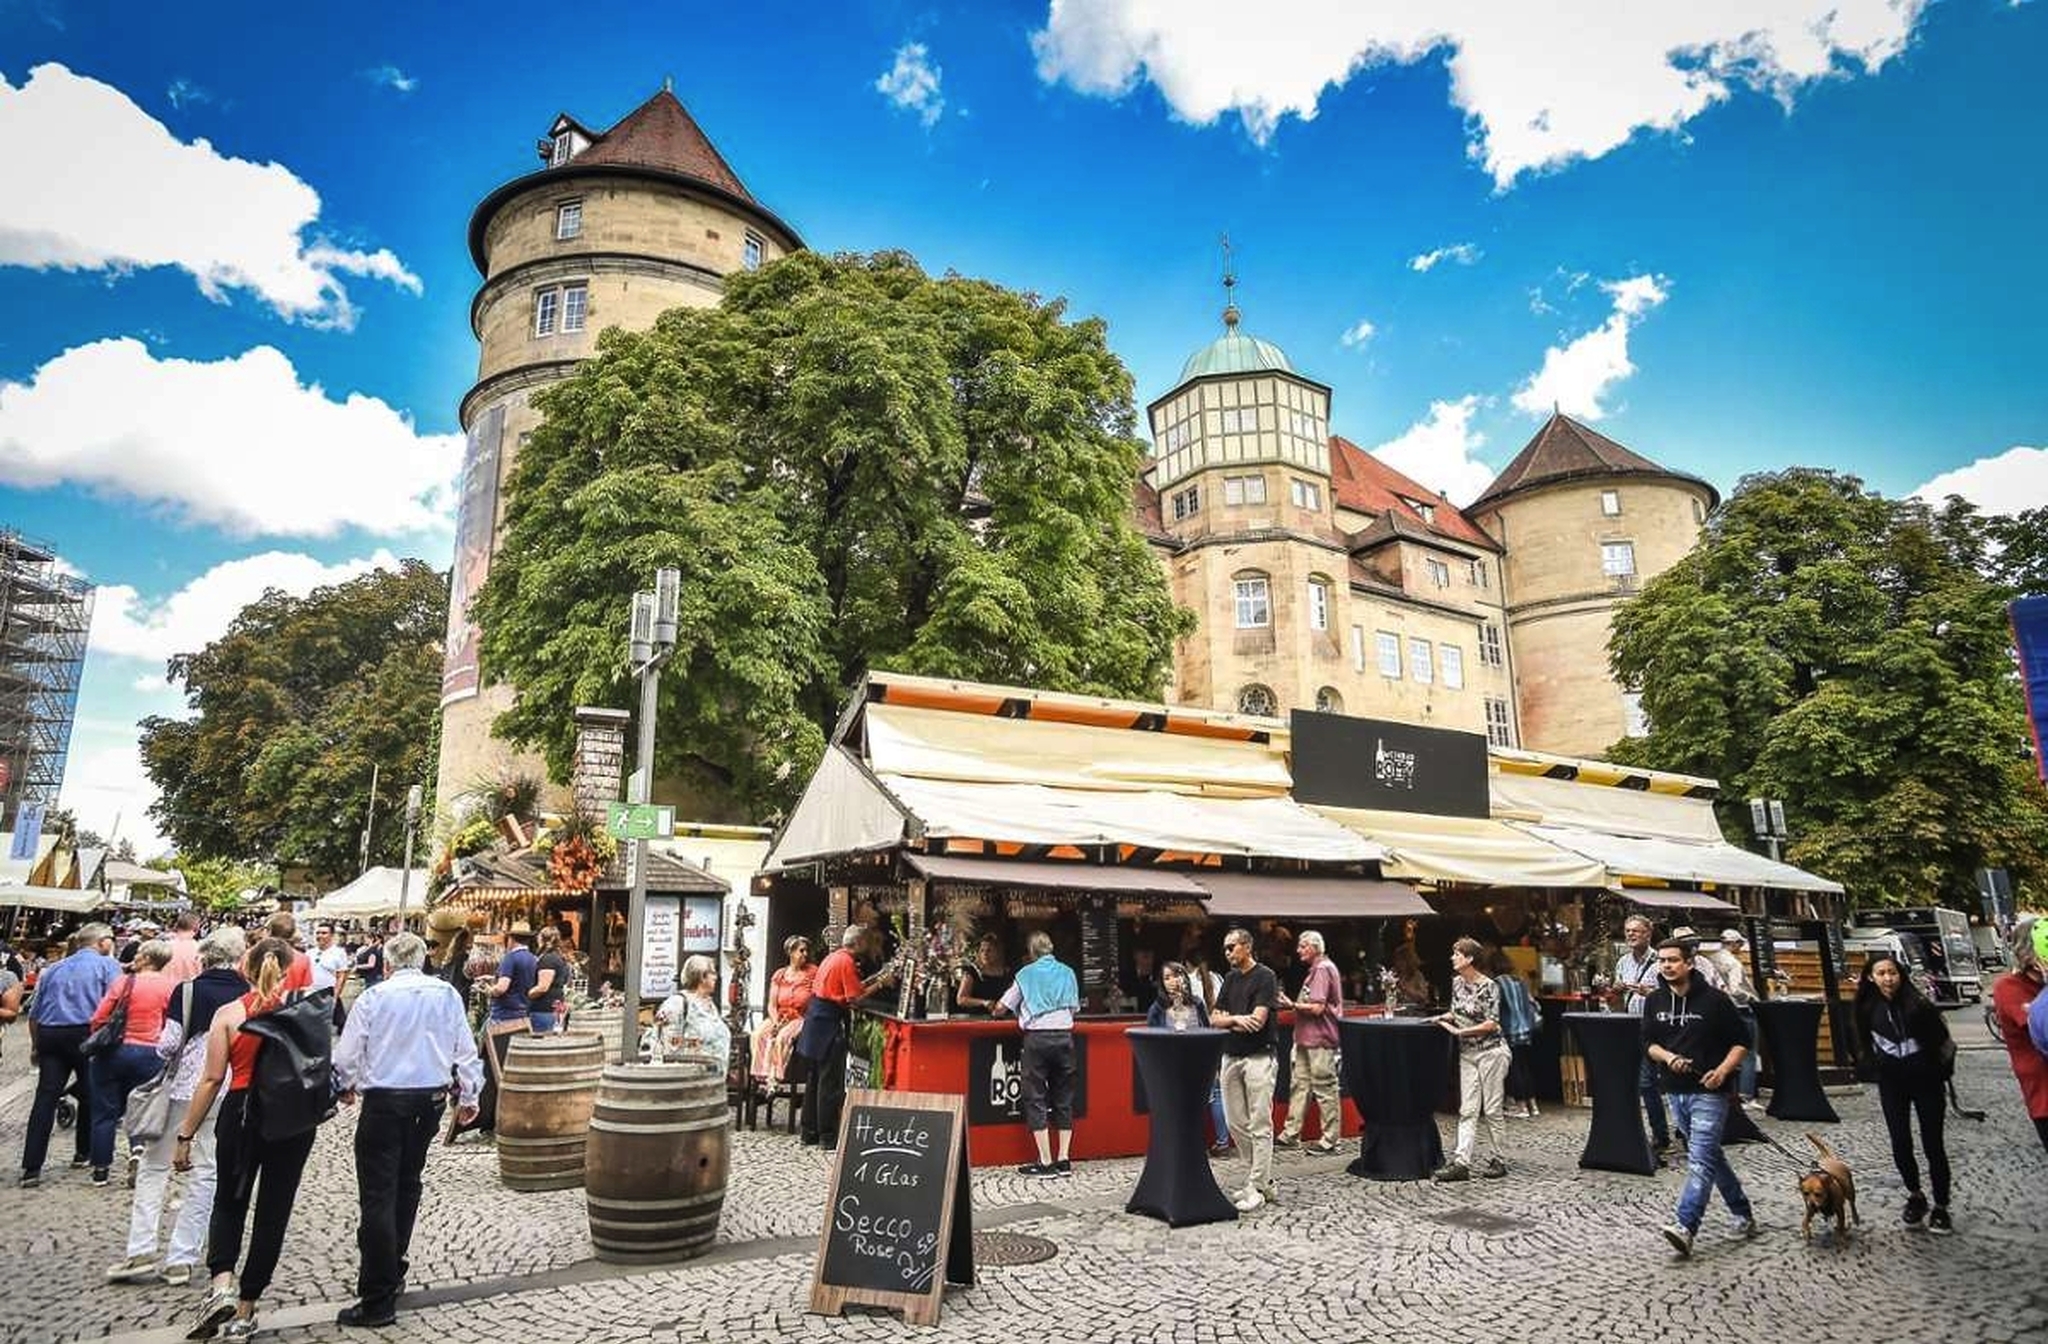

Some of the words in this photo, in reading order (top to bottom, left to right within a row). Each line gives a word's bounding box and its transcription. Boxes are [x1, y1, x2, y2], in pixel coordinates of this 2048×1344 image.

[853, 1114, 929, 1148] Heute
[854, 1161, 868, 1183] 1
[836, 1194, 912, 1238] Secco
